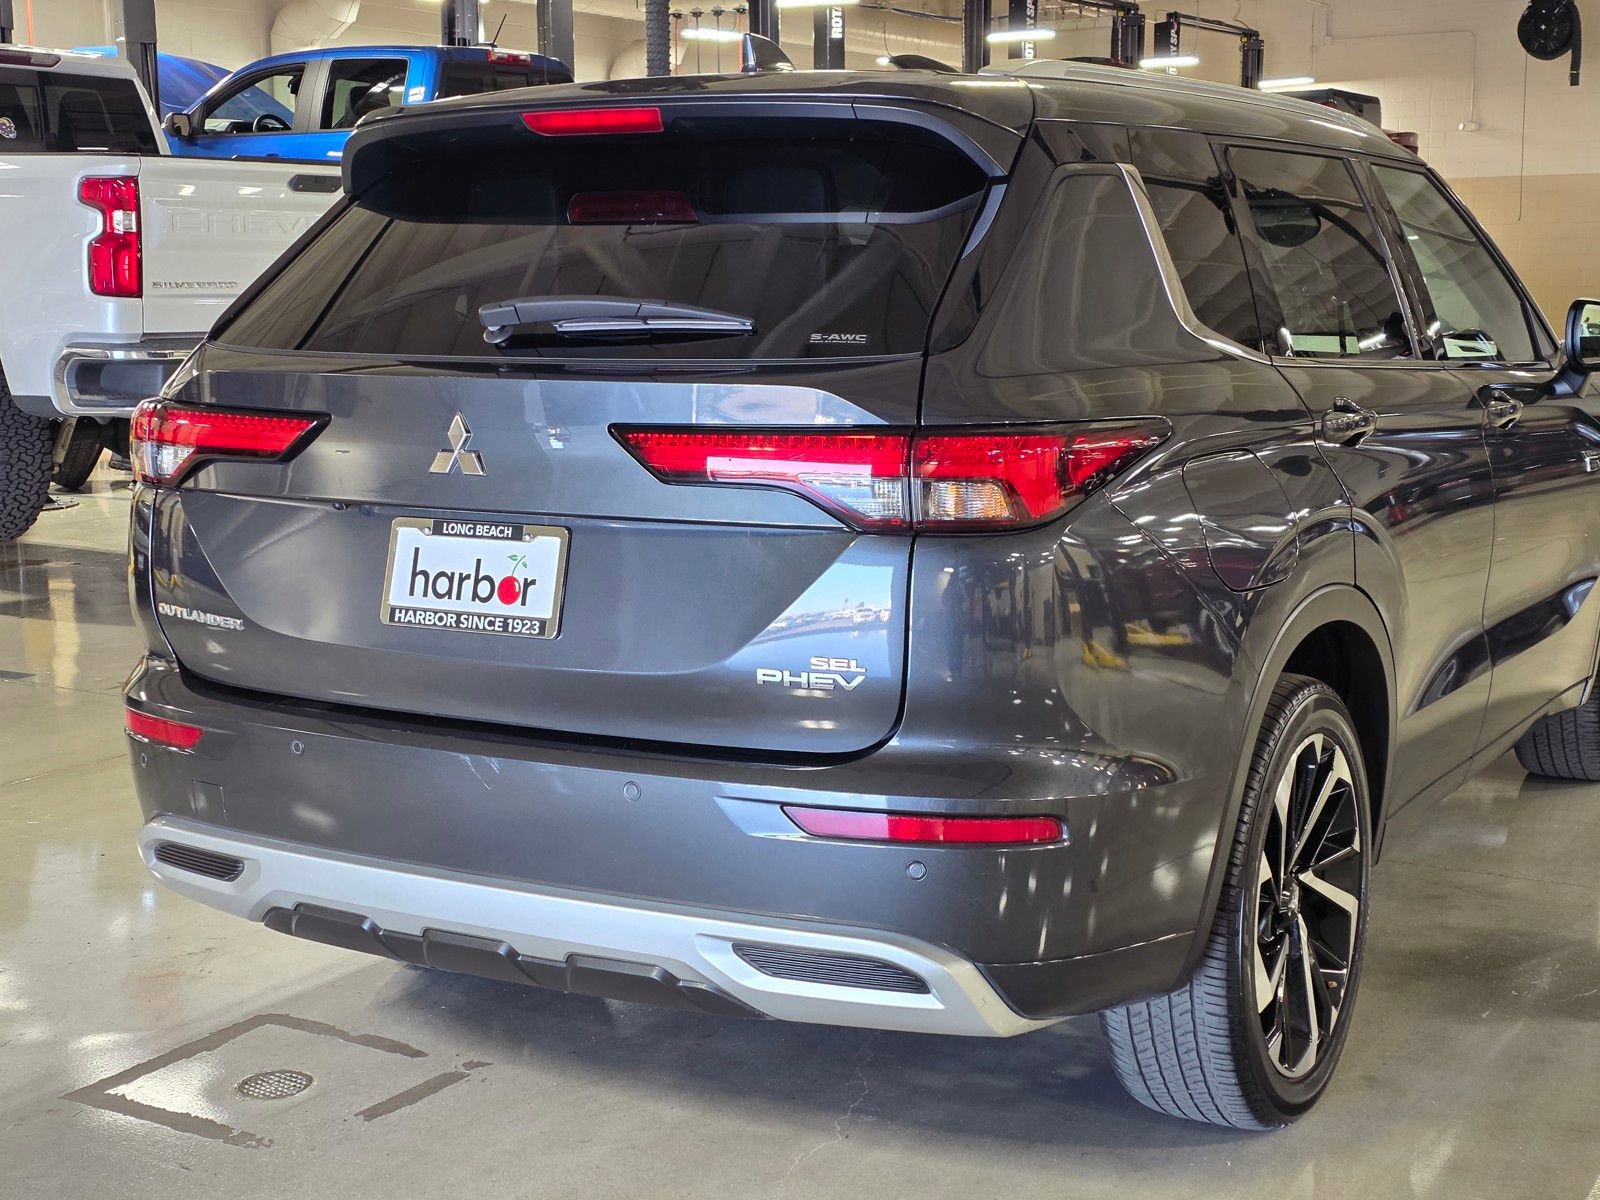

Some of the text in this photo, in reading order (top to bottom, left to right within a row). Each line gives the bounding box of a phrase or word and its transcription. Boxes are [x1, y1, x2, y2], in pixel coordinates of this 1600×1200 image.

[168, 211, 314, 235] CHEV
[151, 281, 238, 289] SILVERADO
[443, 523, 513, 538] LONG BEACH
[408, 547, 537, 607] harbor
[158, 602, 245, 631] OUTLANDER
[394, 609, 540, 635] HARBOR SINCE 1923
[809, 656, 867, 672] SEL
[756, 668, 867, 691] PHEV
